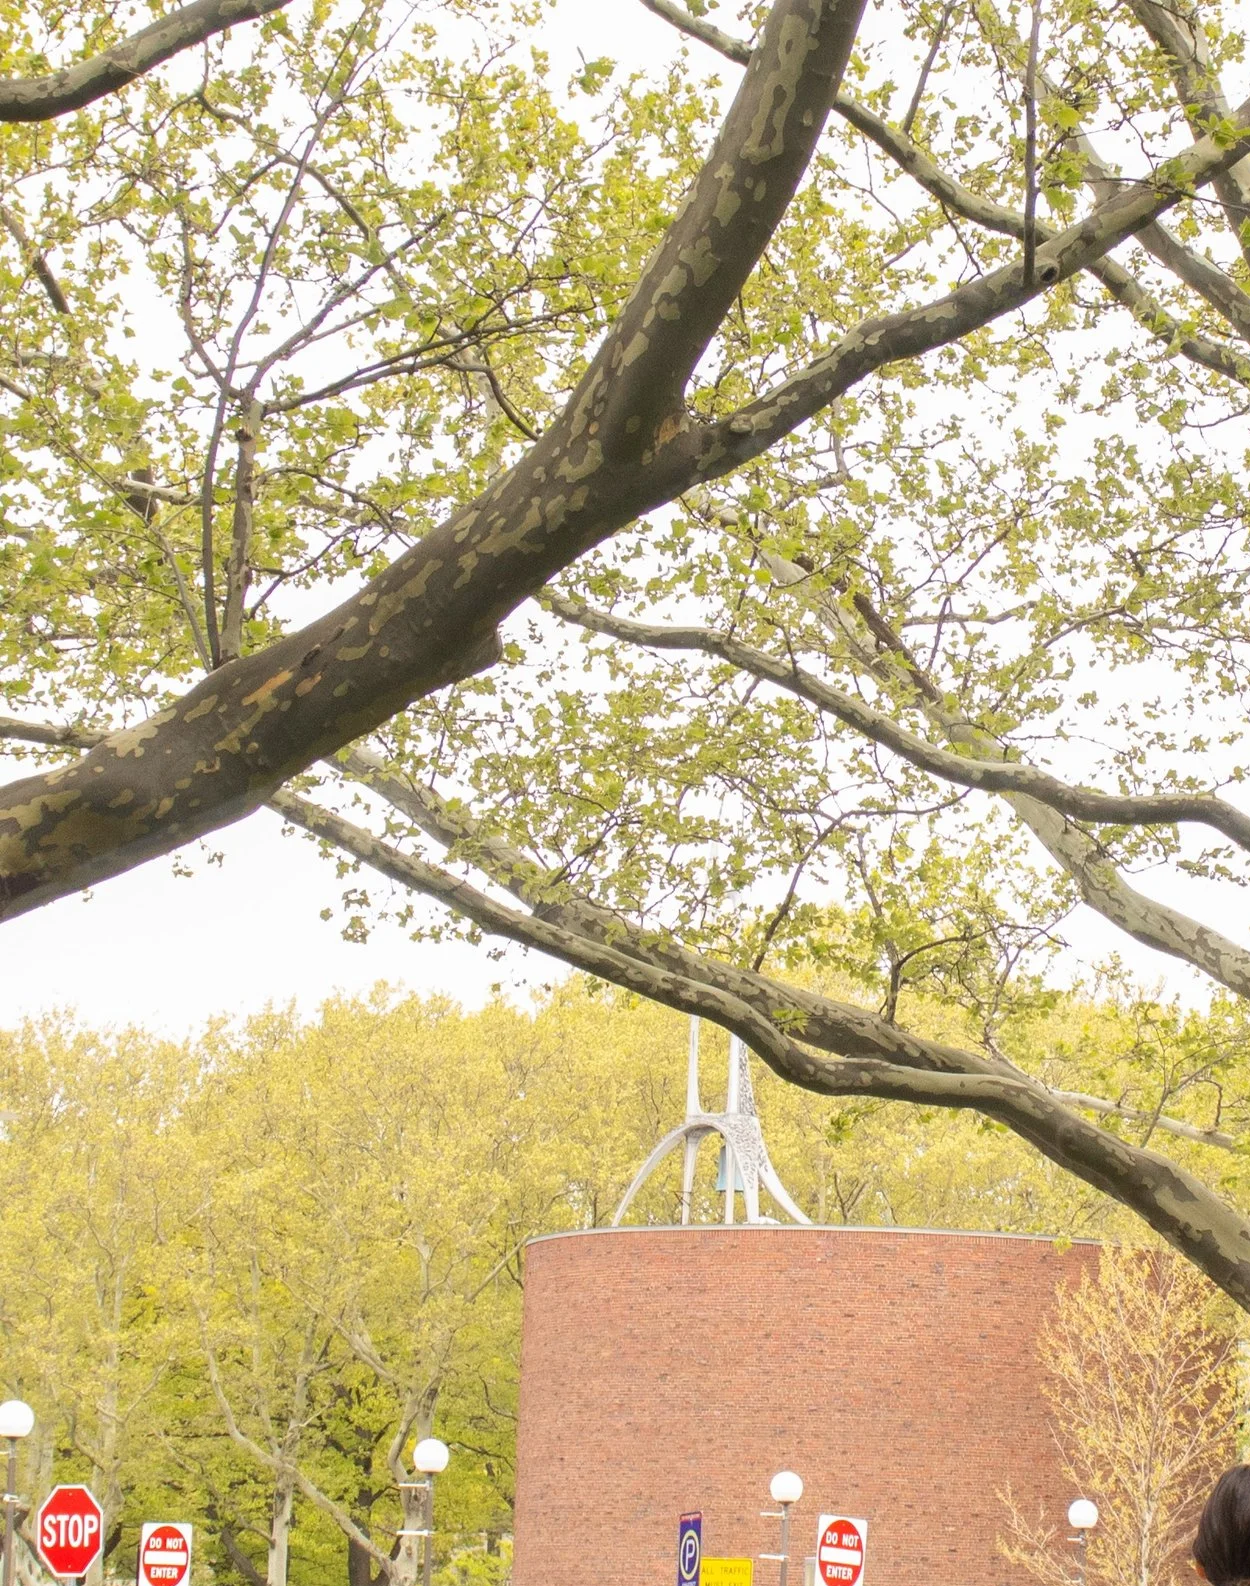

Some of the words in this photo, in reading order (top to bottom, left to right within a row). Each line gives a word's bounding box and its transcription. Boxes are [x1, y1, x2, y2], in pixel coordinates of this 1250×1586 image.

[42, 1514, 99, 1548] STOP
[149, 1537, 162, 1549] DO
[166, 1537, 184, 1549] NOT
[825, 1531, 838, 1545] DO
[842, 1533, 860, 1548] NOT
[685, 1538, 696, 1571] P
[150, 1567, 179, 1579] ENTER
[701, 1567, 714, 1576] ALL
[720, 1567, 749, 1576] TRAFFIC
[826, 1564, 854, 1580] ENTER
